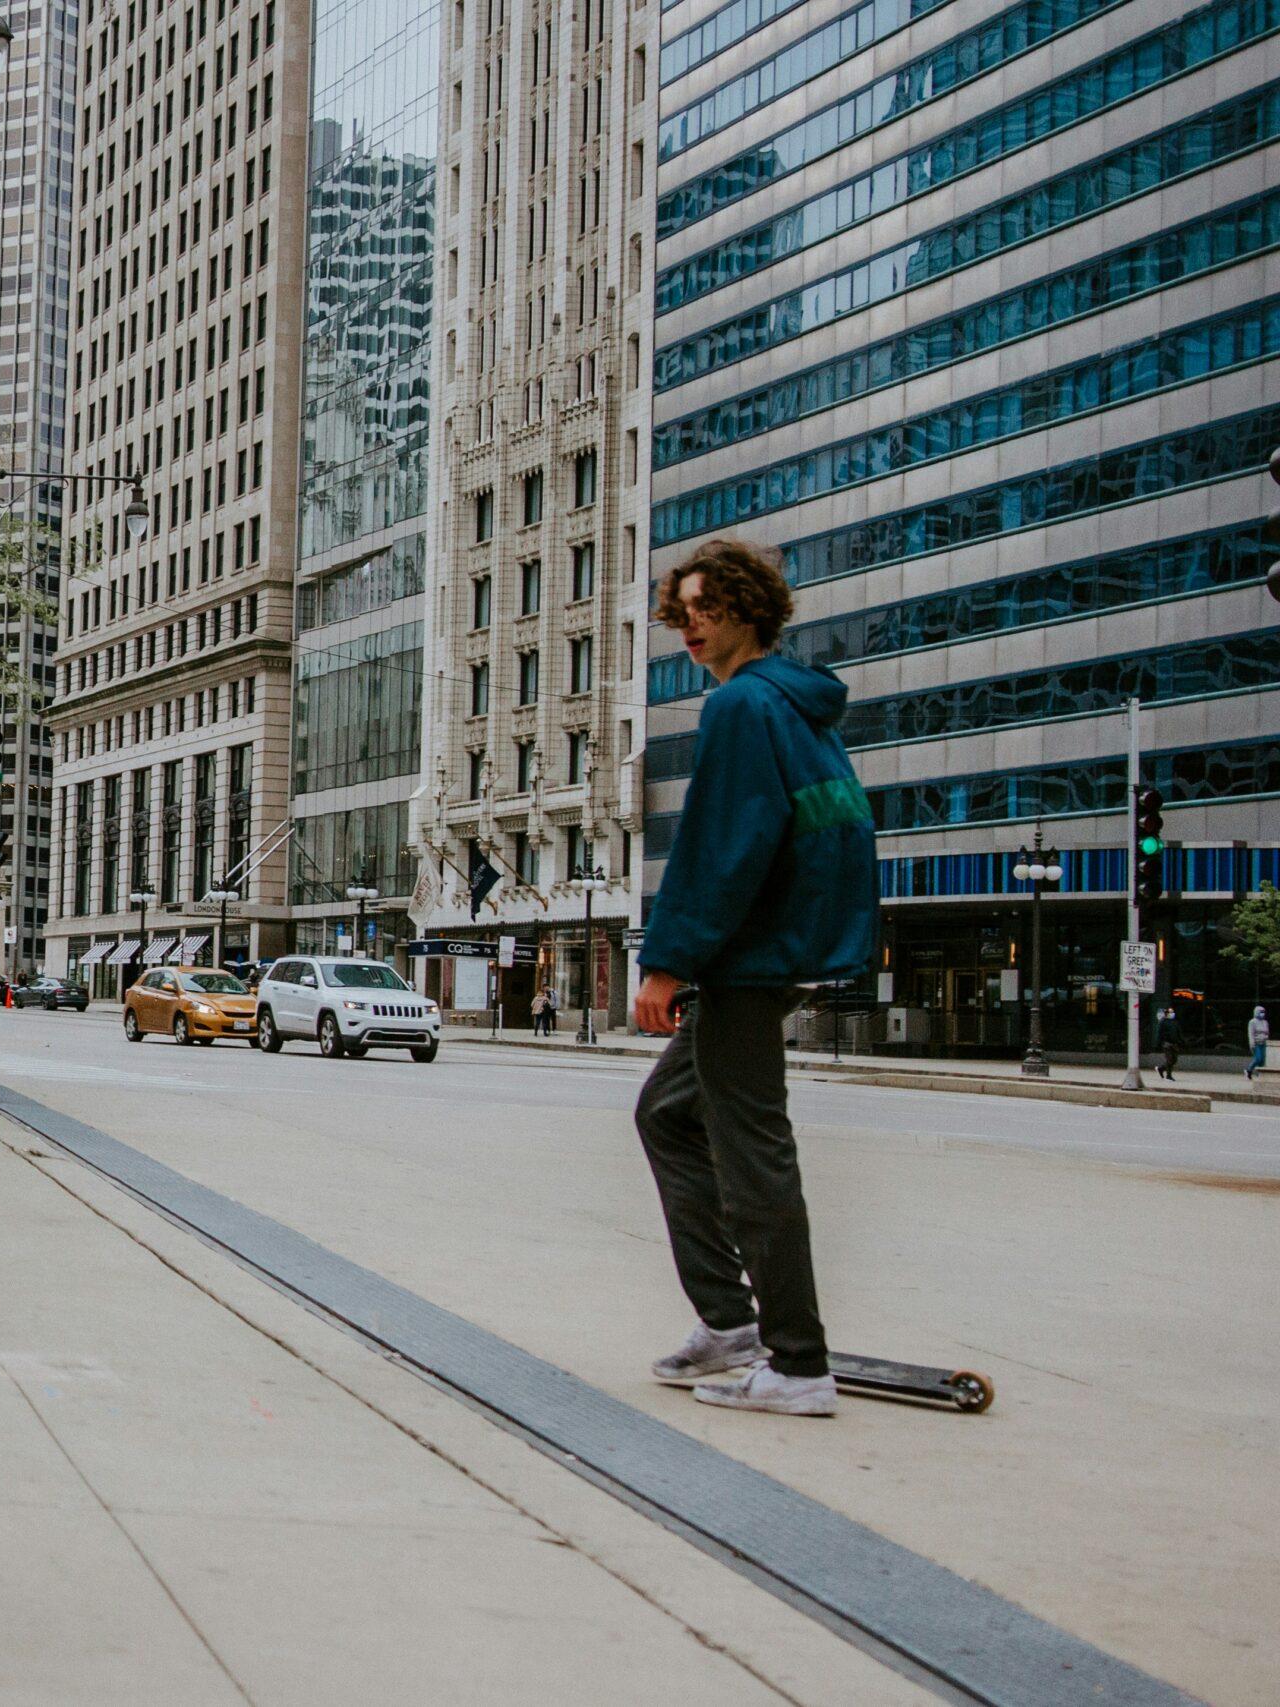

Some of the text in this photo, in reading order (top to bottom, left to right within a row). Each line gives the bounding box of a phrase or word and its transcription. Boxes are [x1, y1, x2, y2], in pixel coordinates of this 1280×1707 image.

[194, 904, 242, 915] LONDONOUSE
[447, 943, 463, 954] CQ
[1124, 945, 1141, 955] LEFT
